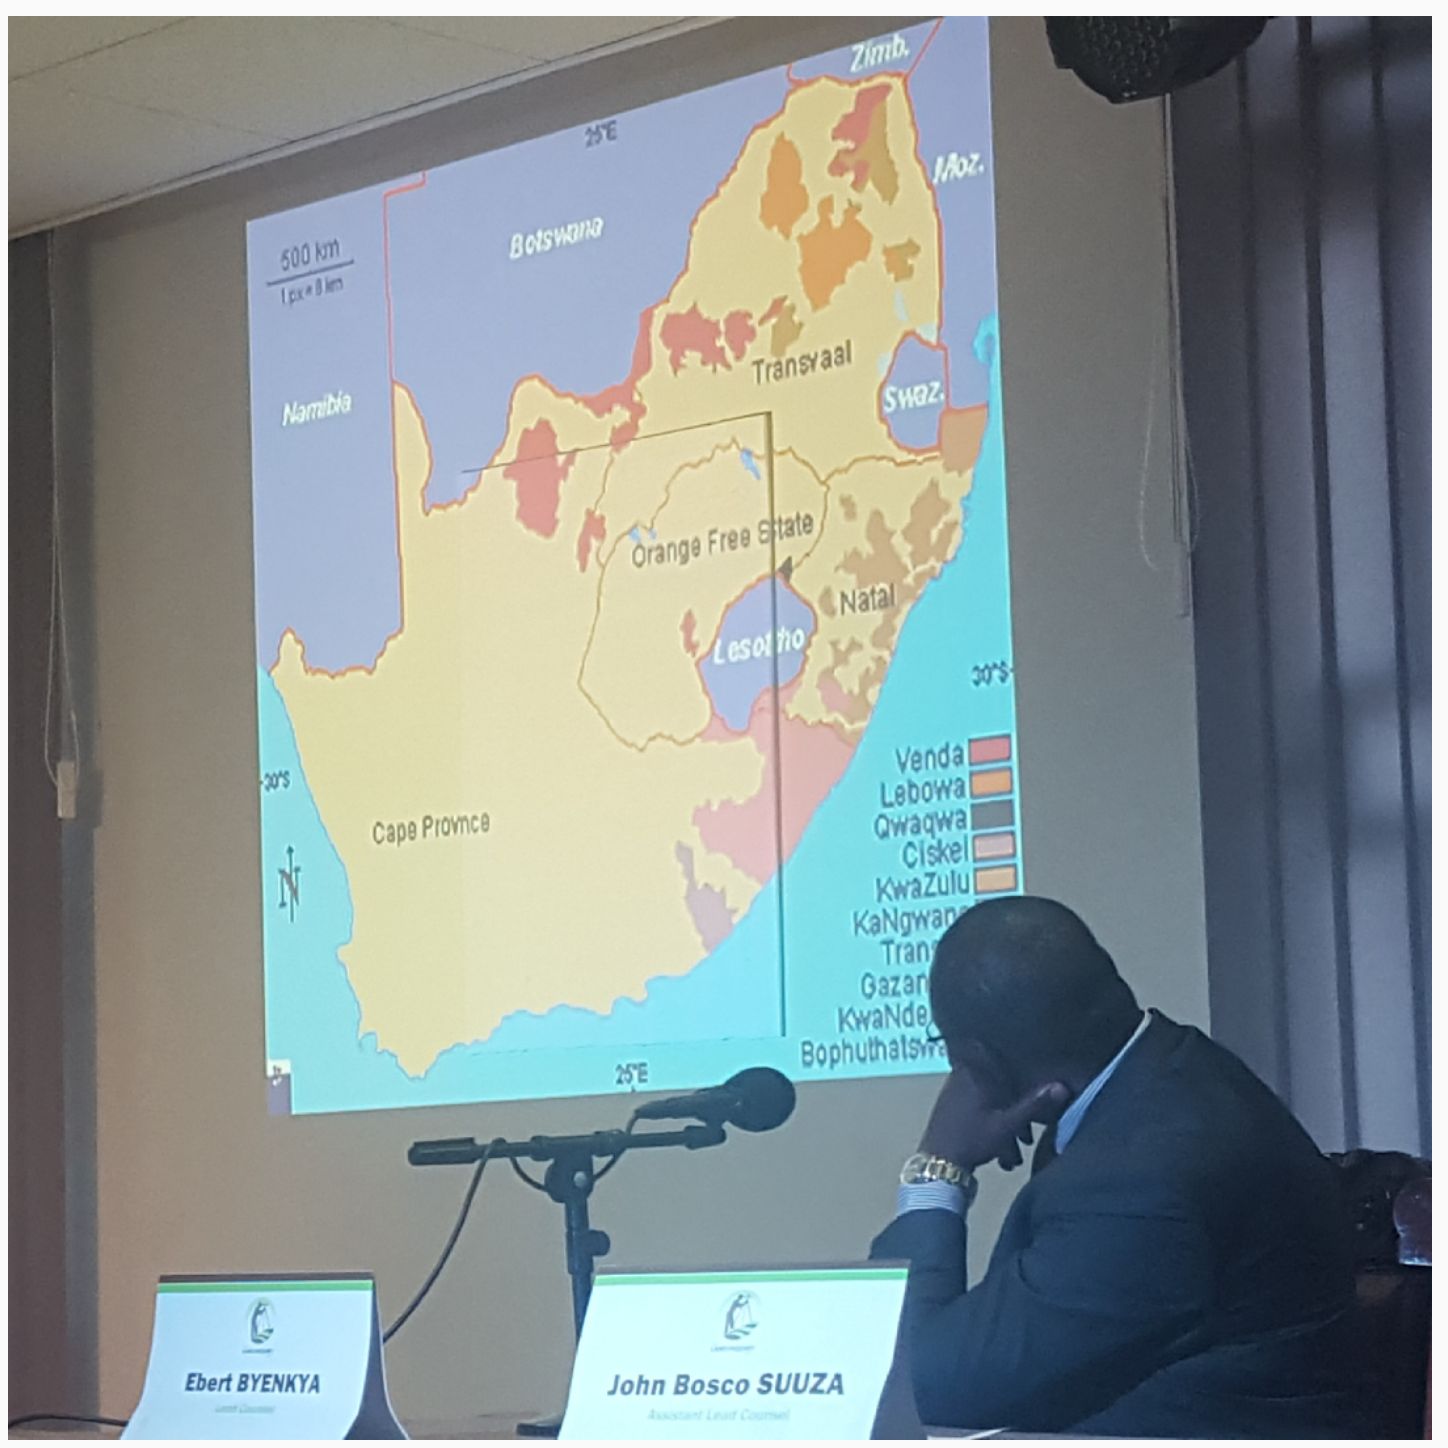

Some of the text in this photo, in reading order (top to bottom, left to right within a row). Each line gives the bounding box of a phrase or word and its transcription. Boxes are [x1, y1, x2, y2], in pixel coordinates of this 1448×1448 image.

[850, 33, 910, 72] Zimb.
[933, 152, 985, 184] Moz.
[509, 214, 604, 259] Botswana
[280, 238, 340, 271] 500 km
[752, 339, 852, 385] Transvaal
[282, 390, 351, 426] Namibia
[884, 381, 945, 413] Swaz.
[631, 511, 814, 569] Orange Free State
[840, 583, 895, 616] Natal
[713, 626, 805, 665] Lesotho
[896, 742, 964, 774] Venda
[880, 775, 966, 809] Lebowa
[372, 821, 417, 848] Cape
[874, 806, 968, 841] Qwaqwa
[902, 837, 970, 869] Ciskei
[876, 870, 970, 903] KwaZulu
[881, 939, 937, 966] Tran
[861, 972, 929, 999] Gazan
[838, 1001, 928, 1033] KwaNde
[801, 1034, 947, 1069] Bophuthatswa
[184, 1372, 321, 1394] Ebert BYENKYA
[607, 1372, 845, 1396] John Bosco SUUZA
